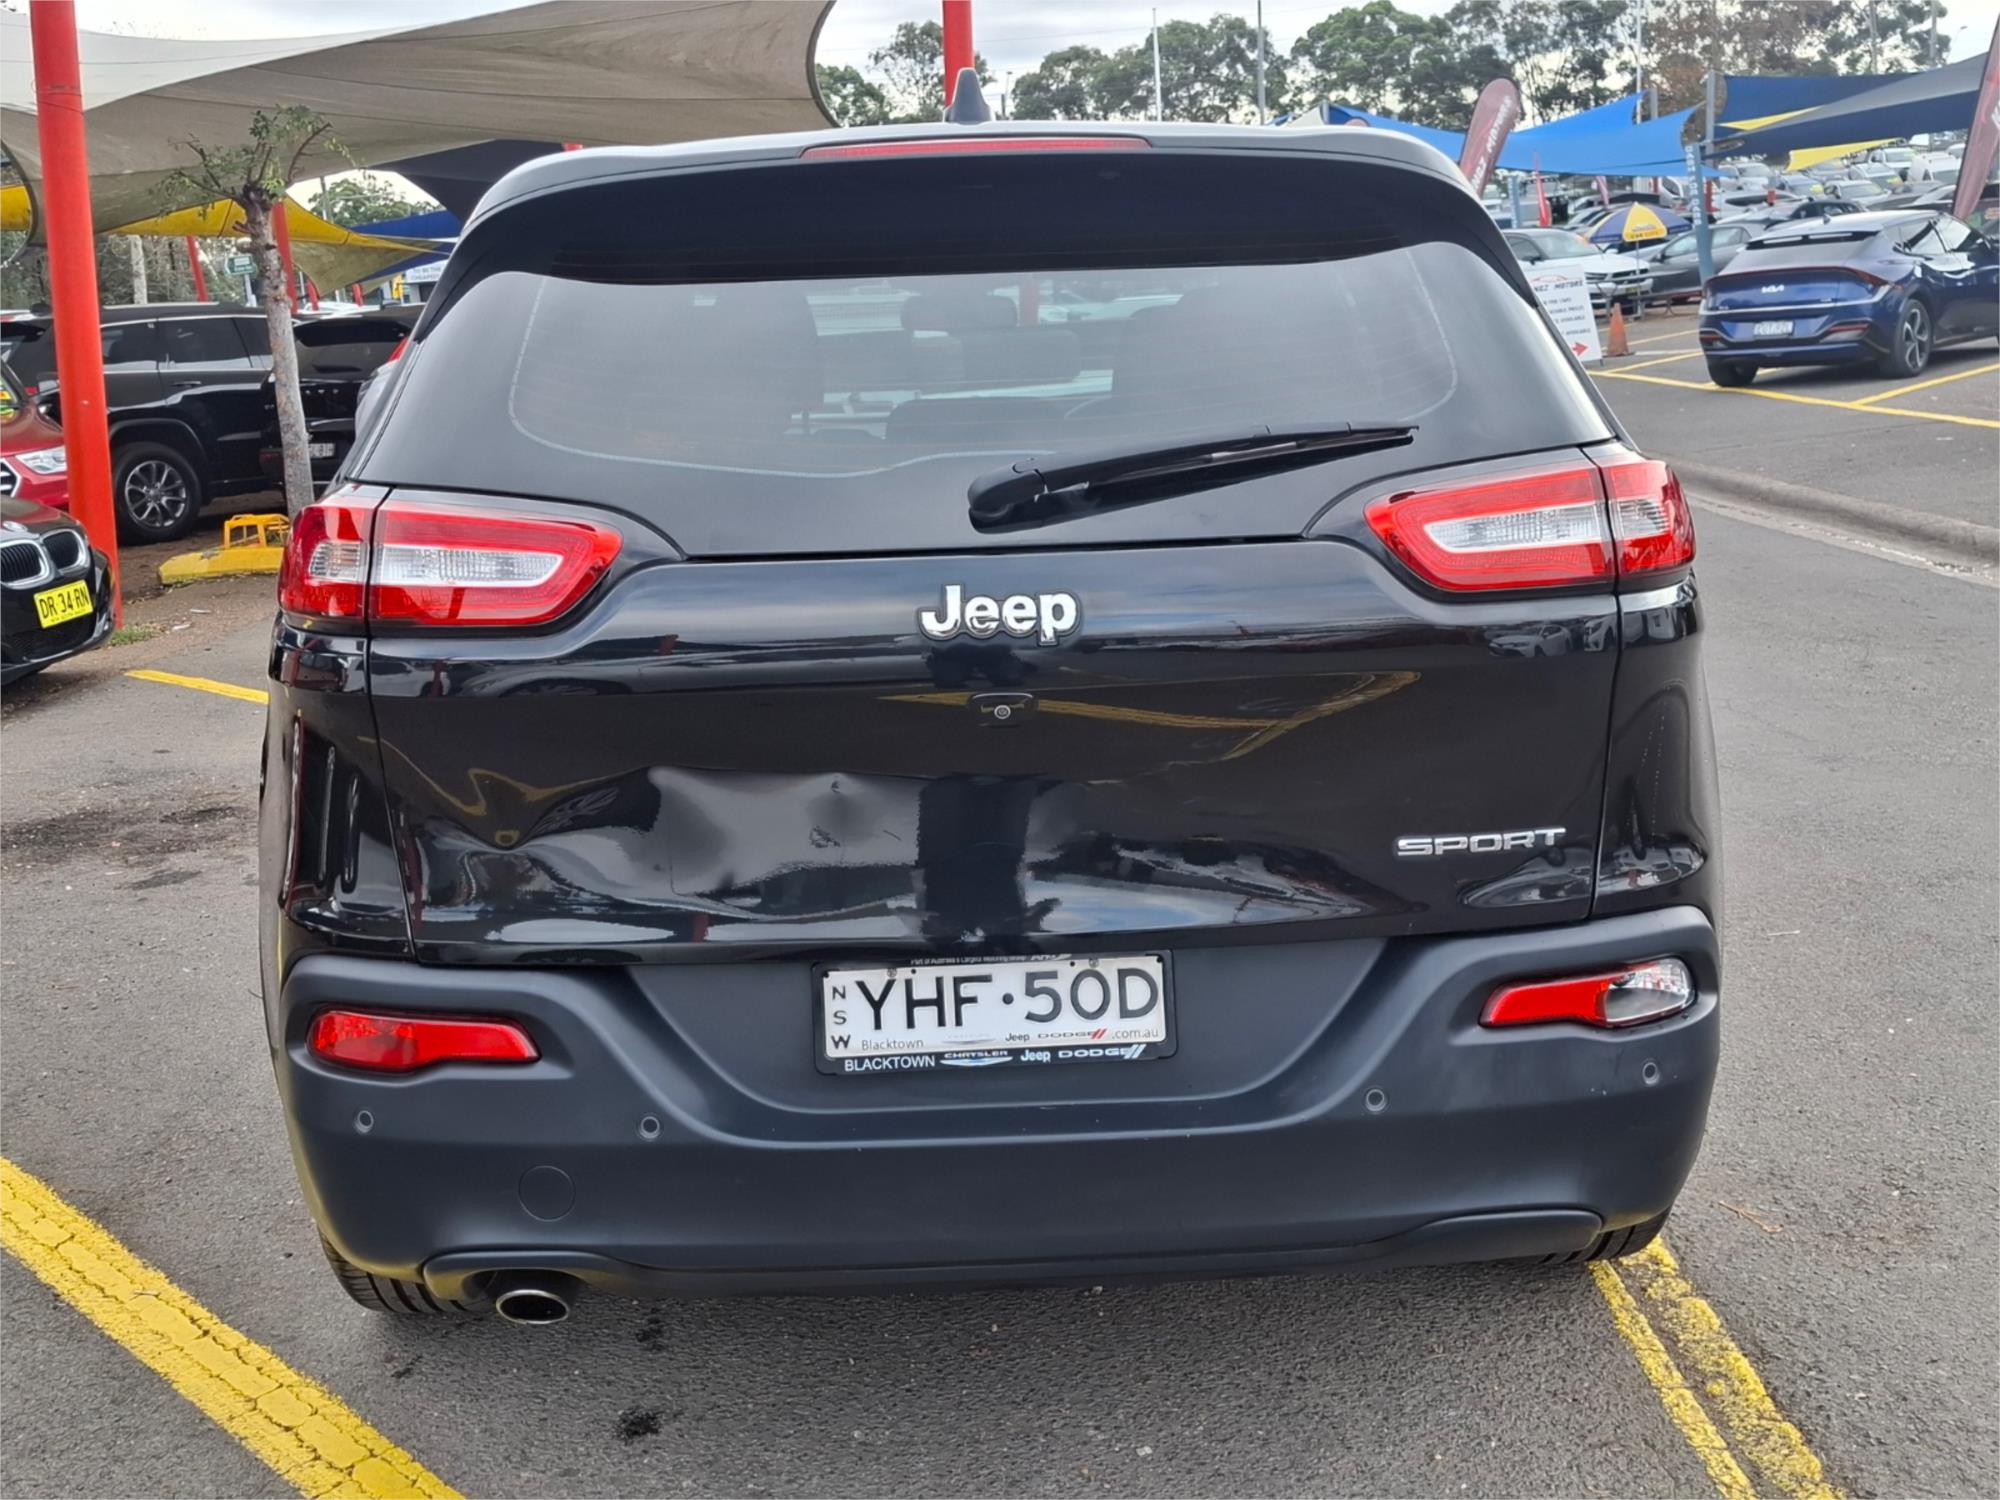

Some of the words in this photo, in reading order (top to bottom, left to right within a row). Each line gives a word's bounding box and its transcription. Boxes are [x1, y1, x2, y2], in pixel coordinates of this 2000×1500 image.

[919, 584, 1078, 643] Jeep
[1397, 827, 1567, 856] SPORT
[861, 1038, 924, 1051] Blacktown
[1005, 1032, 1030, 1043] Jeep
[1111, 1028, 1159, 1040] .com.au
[844, 1055, 936, 1072] BLACKTOWN
[943, 1050, 1009, 1059] CHRYSLER
[1020, 1049, 1051, 1063] Jeep
